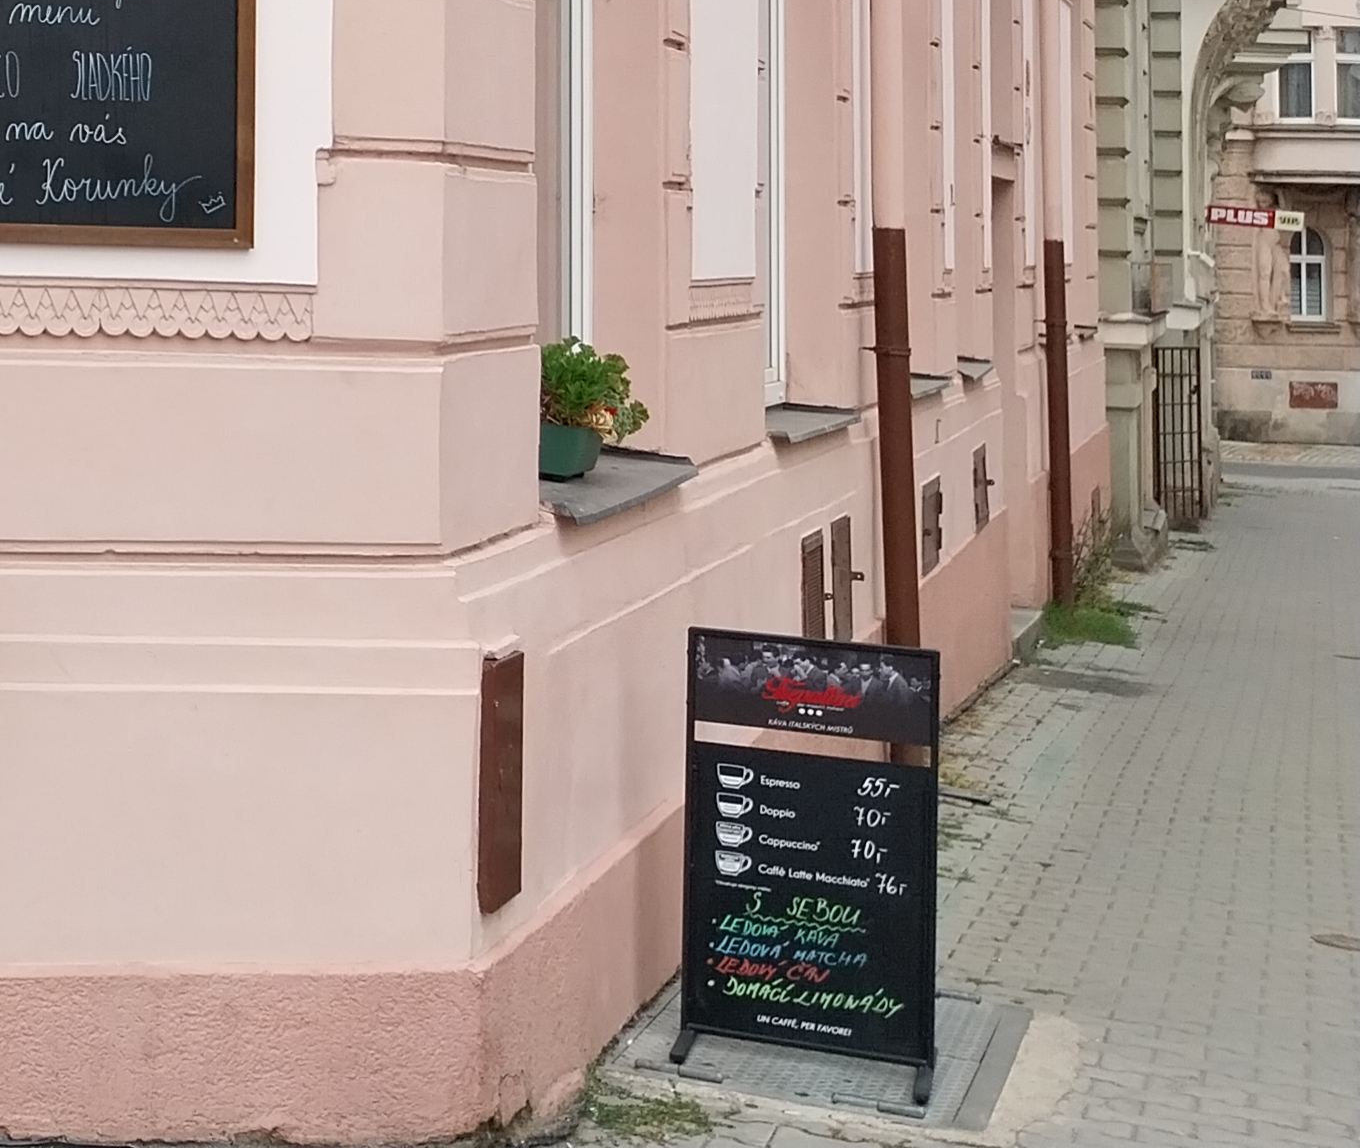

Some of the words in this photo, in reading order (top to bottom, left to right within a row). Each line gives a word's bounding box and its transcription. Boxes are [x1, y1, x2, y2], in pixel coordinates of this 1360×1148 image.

[9, 2, 101, 26] menu
[70, 45, 152, 102] SLADKÉHO
[6, 122, 54, 141] na
[69, 113, 127, 145] vás
[36, 153, 202, 222] Korunky
[1210, 208, 1269, 226] PLUS
[768, 718, 787, 727] KÁVA
[760, 774, 801, 790] Espresso
[759, 804, 796, 819] Doppio
[757, 863, 785, 877] Caffè
[788, 867, 813, 881] Latte
[746, 891, 762, 913] S
[786, 896, 861, 925] SEBOU
[719, 914, 789, 938] LEDOVÁ
[715, 935, 790, 959] LEDOVÁ
[792, 949, 868, 967] MATCHA
[723, 976, 795, 1003] DOMÁCÍ
[792, 988, 904, 1019] LIMONÁDY
[756, 1014, 770, 1024] UN
[800, 1021, 815, 1031] PER
